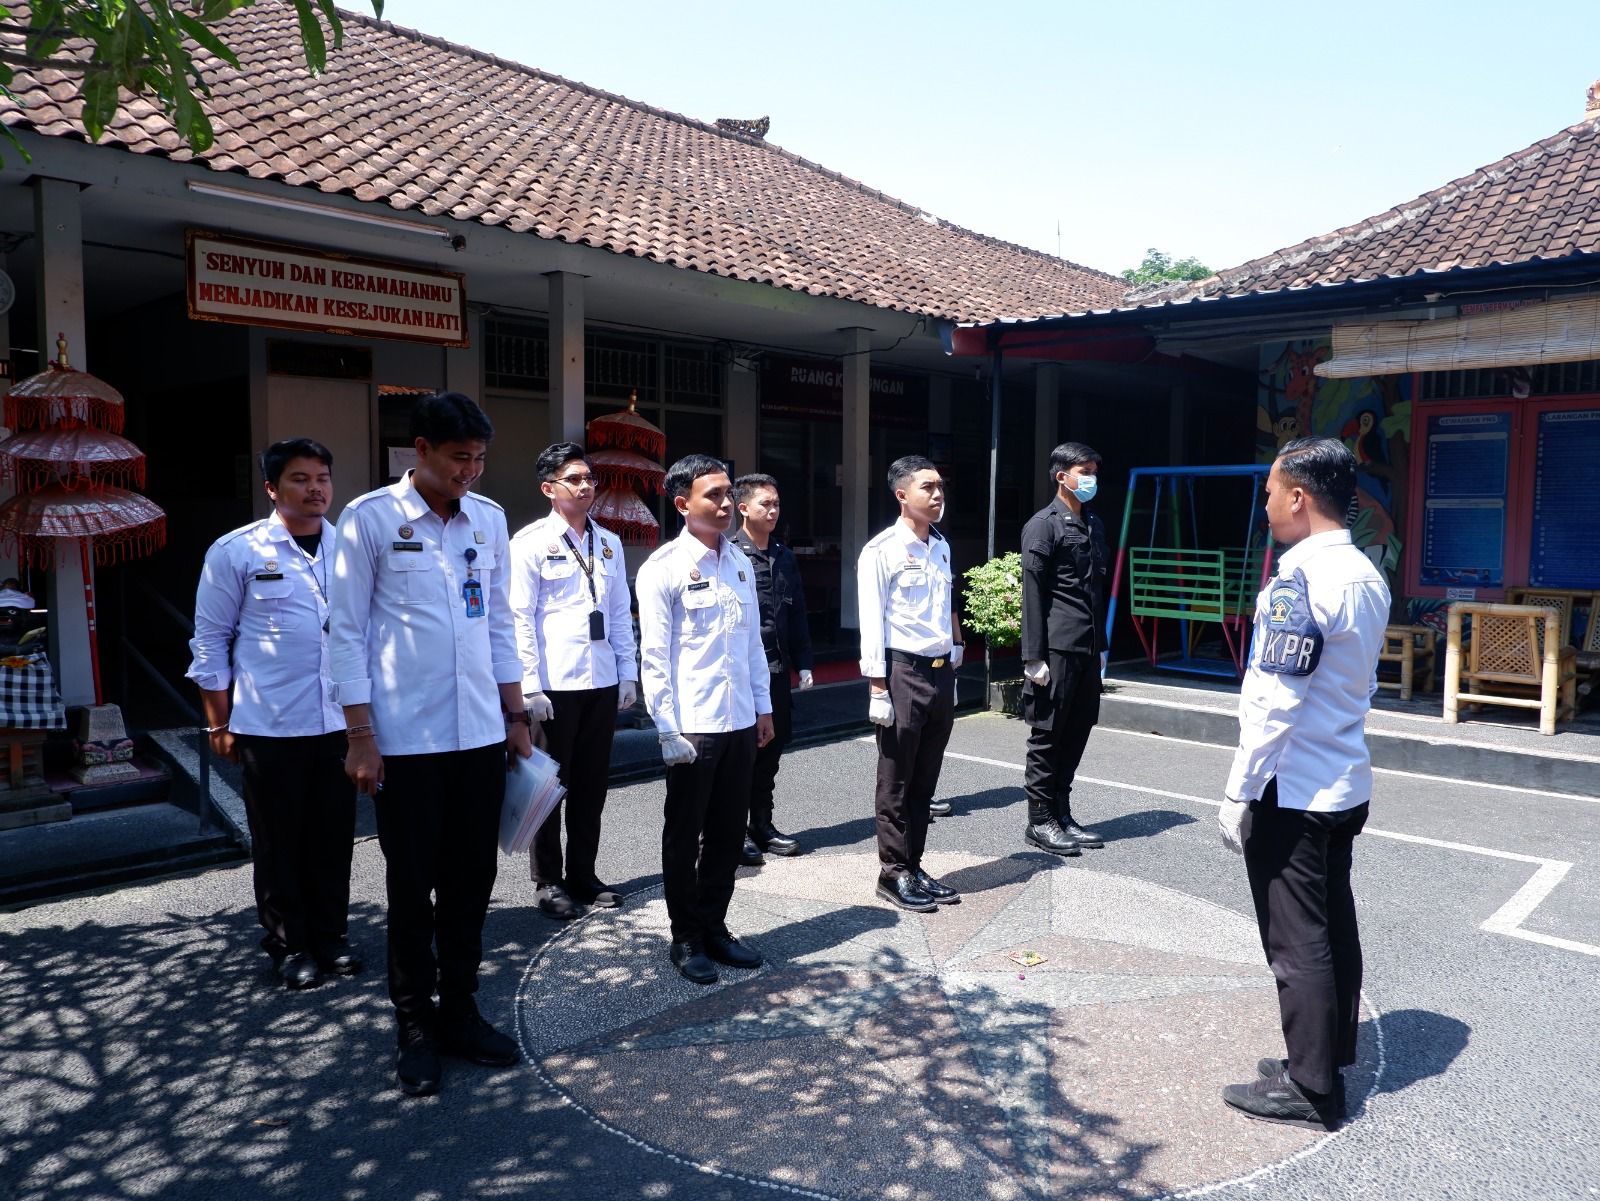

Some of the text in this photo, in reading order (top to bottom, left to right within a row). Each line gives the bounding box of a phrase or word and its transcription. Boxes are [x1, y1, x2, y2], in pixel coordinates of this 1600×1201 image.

[290, 264, 326, 286] DAN
[199, 282, 460, 331] MENJADIKAN KESEJUKAN HATI
[791, 366, 833, 387] RUANG
[1263, 632, 1315, 669] KPR
